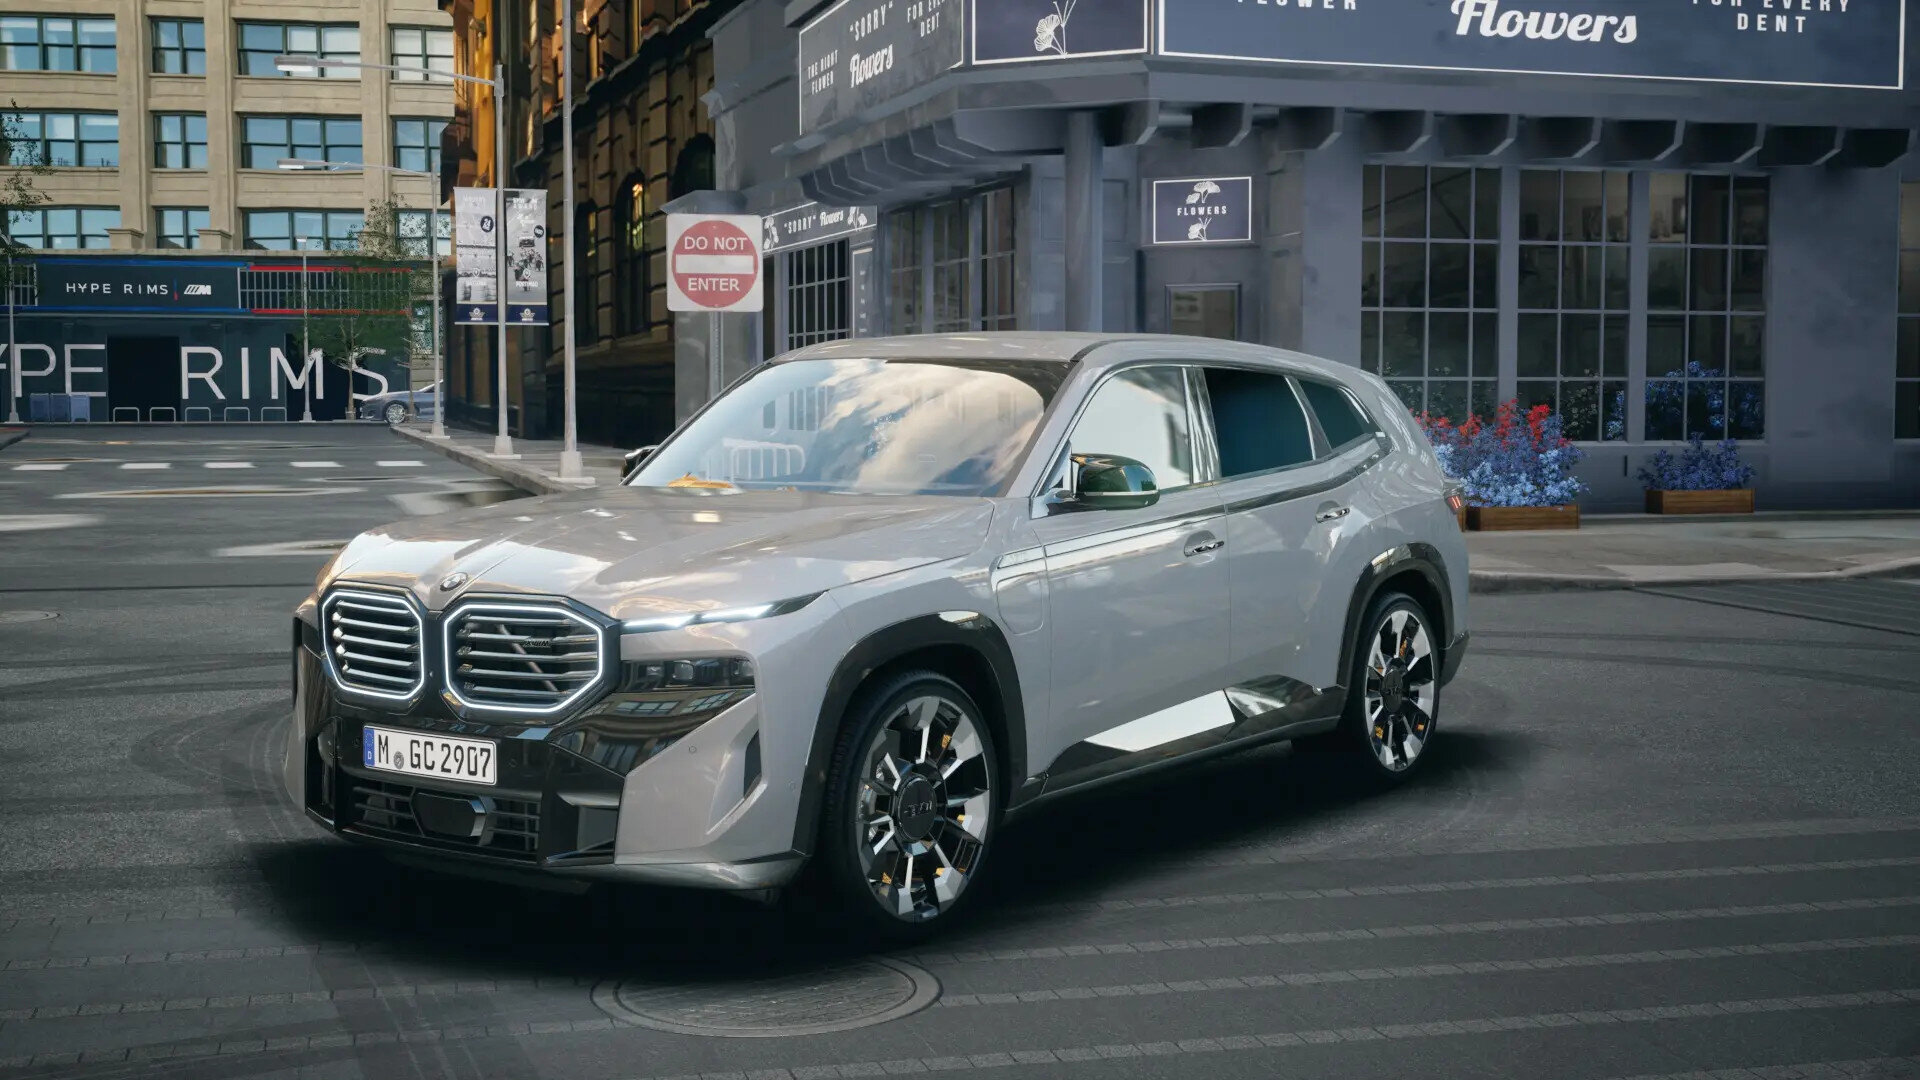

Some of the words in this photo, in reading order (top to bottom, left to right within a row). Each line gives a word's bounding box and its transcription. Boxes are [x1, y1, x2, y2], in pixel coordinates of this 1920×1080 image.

[907, 1, 923, 24] FOR
[1451, 0, 1637, 43] Flowers
[1737, 13, 1806, 33] DENT
[919, 12, 940, 38] DENT
[850, 44, 894, 88] Flowers
[1177, 205, 1227, 216] FLOWERS
[684, 237, 708, 251] DO
[714, 237, 748, 251] NOT
[66, 282, 112, 294] HYPE
[123, 284, 168, 295] RIMS
[688, 278, 740, 292] ENTER
[0, 344, 106, 397] PE
[181, 346, 389, 400] RIMS
[378, 734, 389, 764] M
